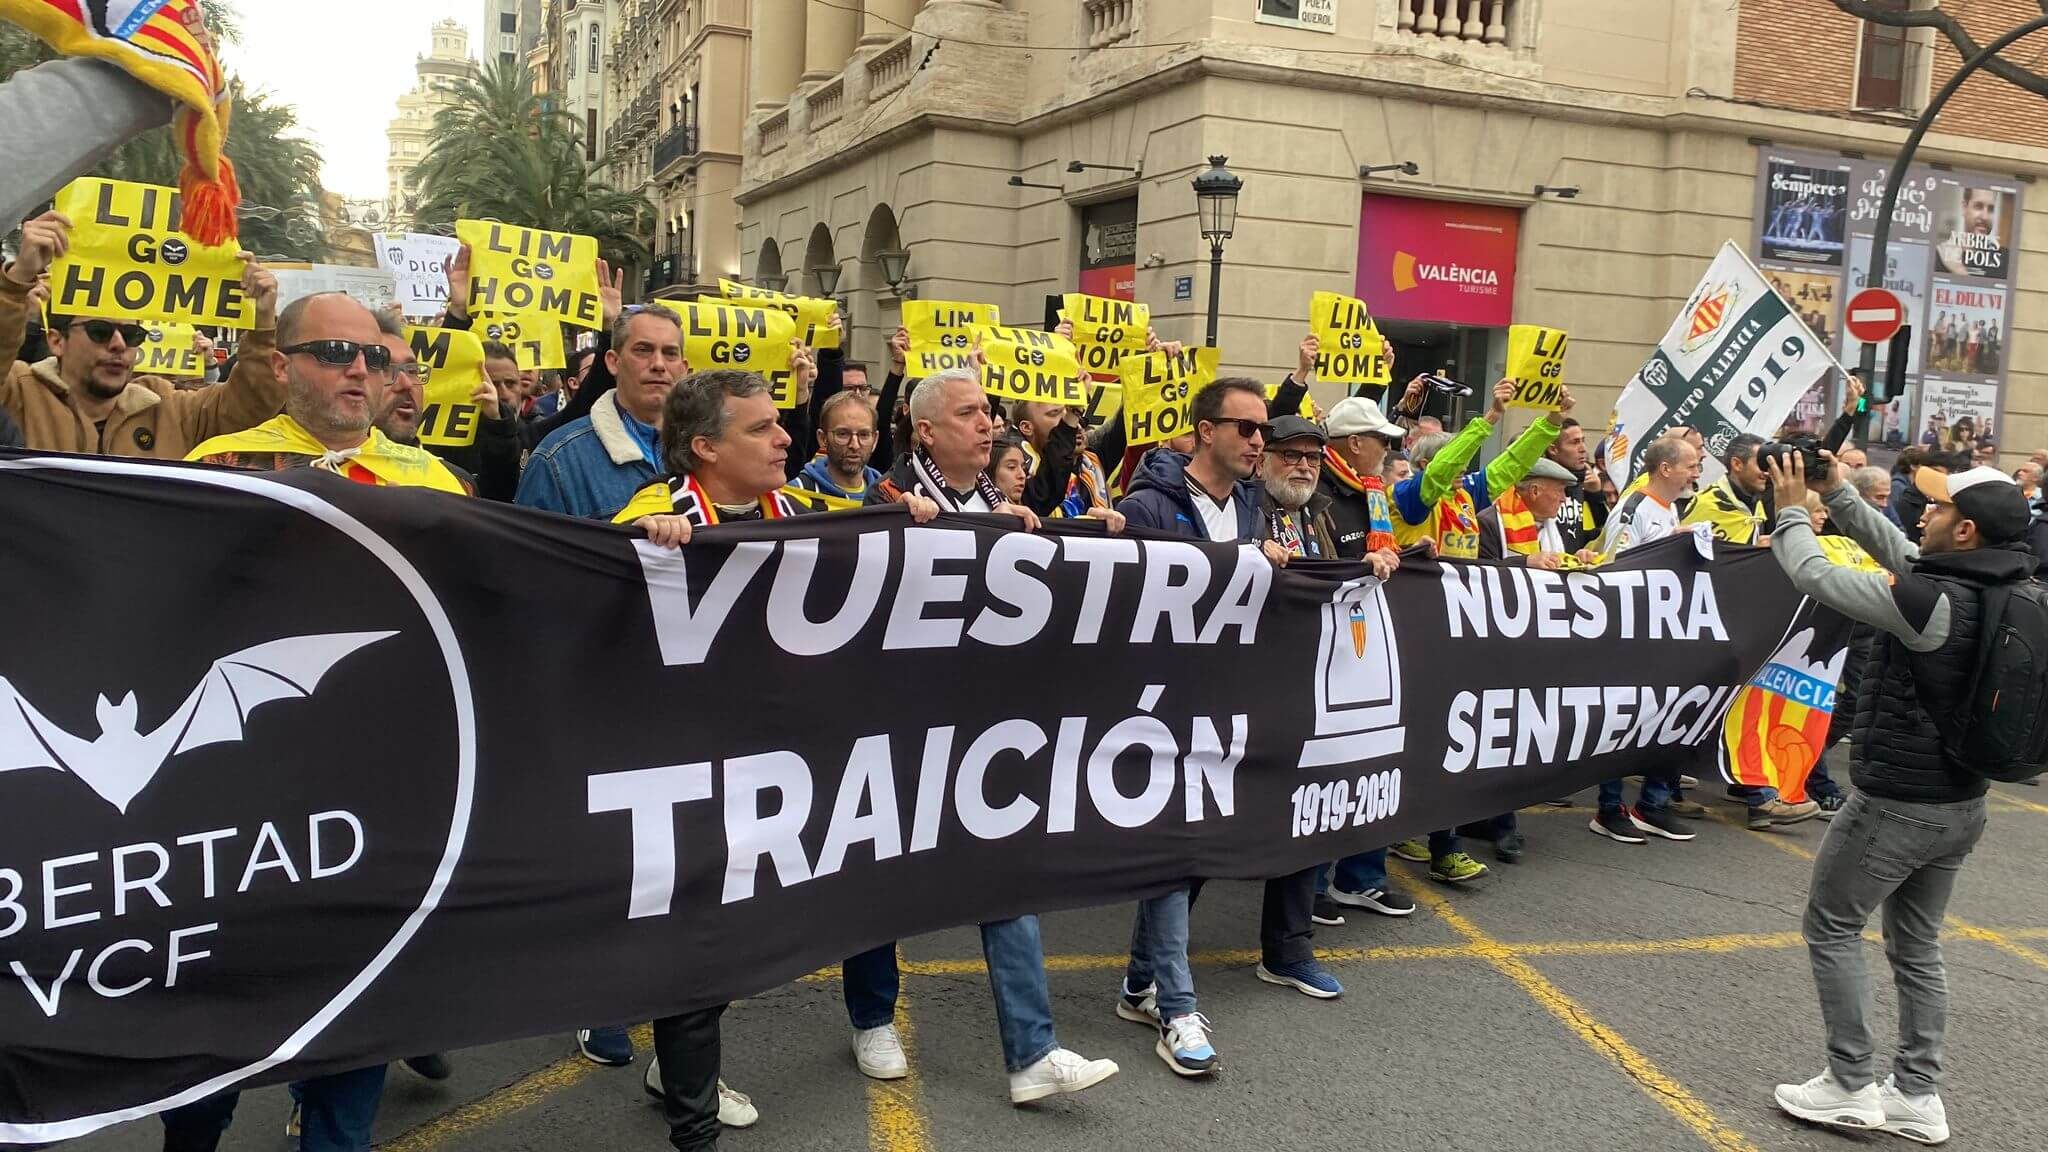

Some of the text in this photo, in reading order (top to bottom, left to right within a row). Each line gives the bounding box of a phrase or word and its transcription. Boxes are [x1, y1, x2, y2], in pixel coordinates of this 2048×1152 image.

[489, 225, 573, 263] LIM
[1964, 249, 2002, 267] POLS
[1418, 262, 1498, 285] VALÈNCIA
[60, 264, 242, 318] HOME
[469, 276, 599, 321] HOME
[688, 305, 767, 338] LIM
[935, 310, 974, 327] LIM
[1084, 298, 1133, 326] LIM
[1329, 302, 1372, 330] LIM
[989, 326, 1055, 349] LIM
[1095, 326, 1124, 343] GO
[1533, 330, 1567, 359] LI
[920, 352, 973, 370] HOM
[1314, 352, 1384, 378] HOME
[1671, 388, 1705, 425] PUTO
[1701, 319, 1762, 388] VALENCIA
[985, 365, 1081, 400] HOME
[1733, 336, 1805, 427] 1919
[629, 526, 1273, 666] VUESTRA
[1439, 561, 1730, 642] NUESTRA
[587, 684, 1248, 919] TRAICIÓN
[1291, 767, 1401, 838] 1919-2030
[10, 922, 218, 1017] VCF
